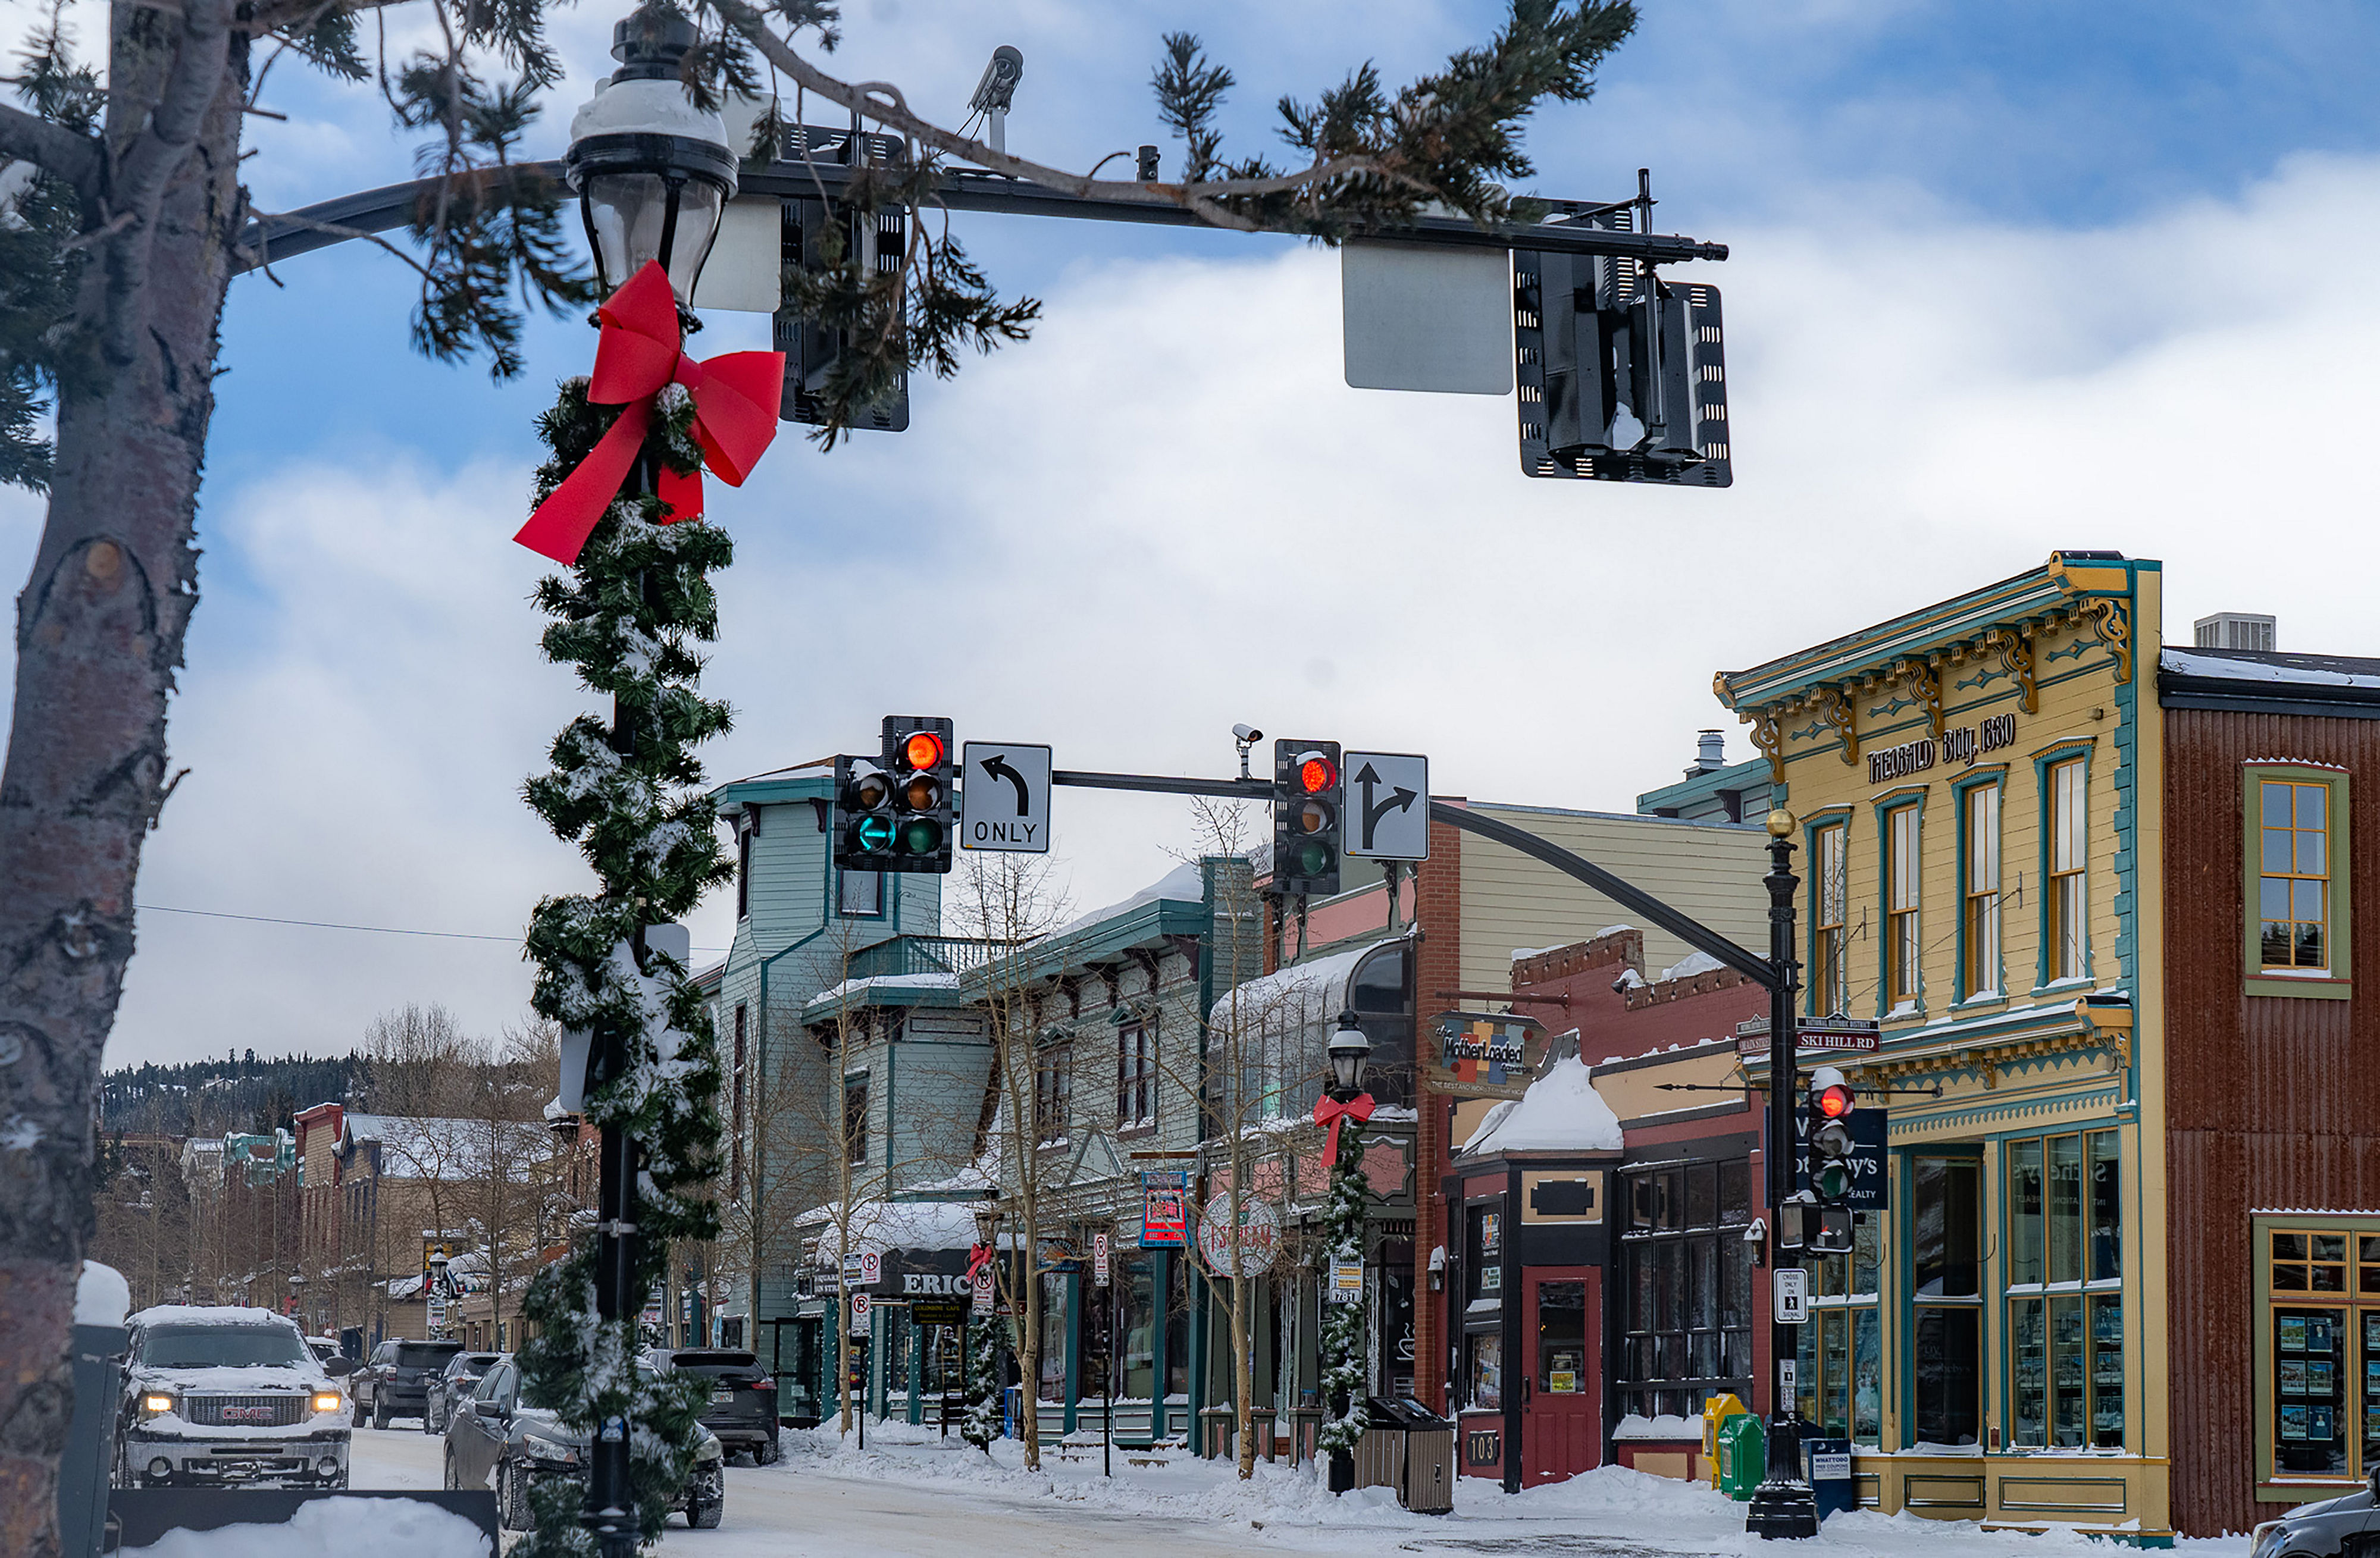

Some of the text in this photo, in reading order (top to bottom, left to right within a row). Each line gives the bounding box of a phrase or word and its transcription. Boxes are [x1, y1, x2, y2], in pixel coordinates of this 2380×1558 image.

[1867, 738, 1935, 784] THEOBALD
[1981, 713, 2016, 752] 1880
[975, 822, 1037, 842] ONLY
[1444, 1037, 1523, 1063] MotherLoaded
[1802, 1035, 1875, 1049] SKI HILL RD
[1336, 1293, 1355, 1302] 781
[223, 1407, 273, 1419] GMC
[1471, 1436, 1493, 1461] 103
